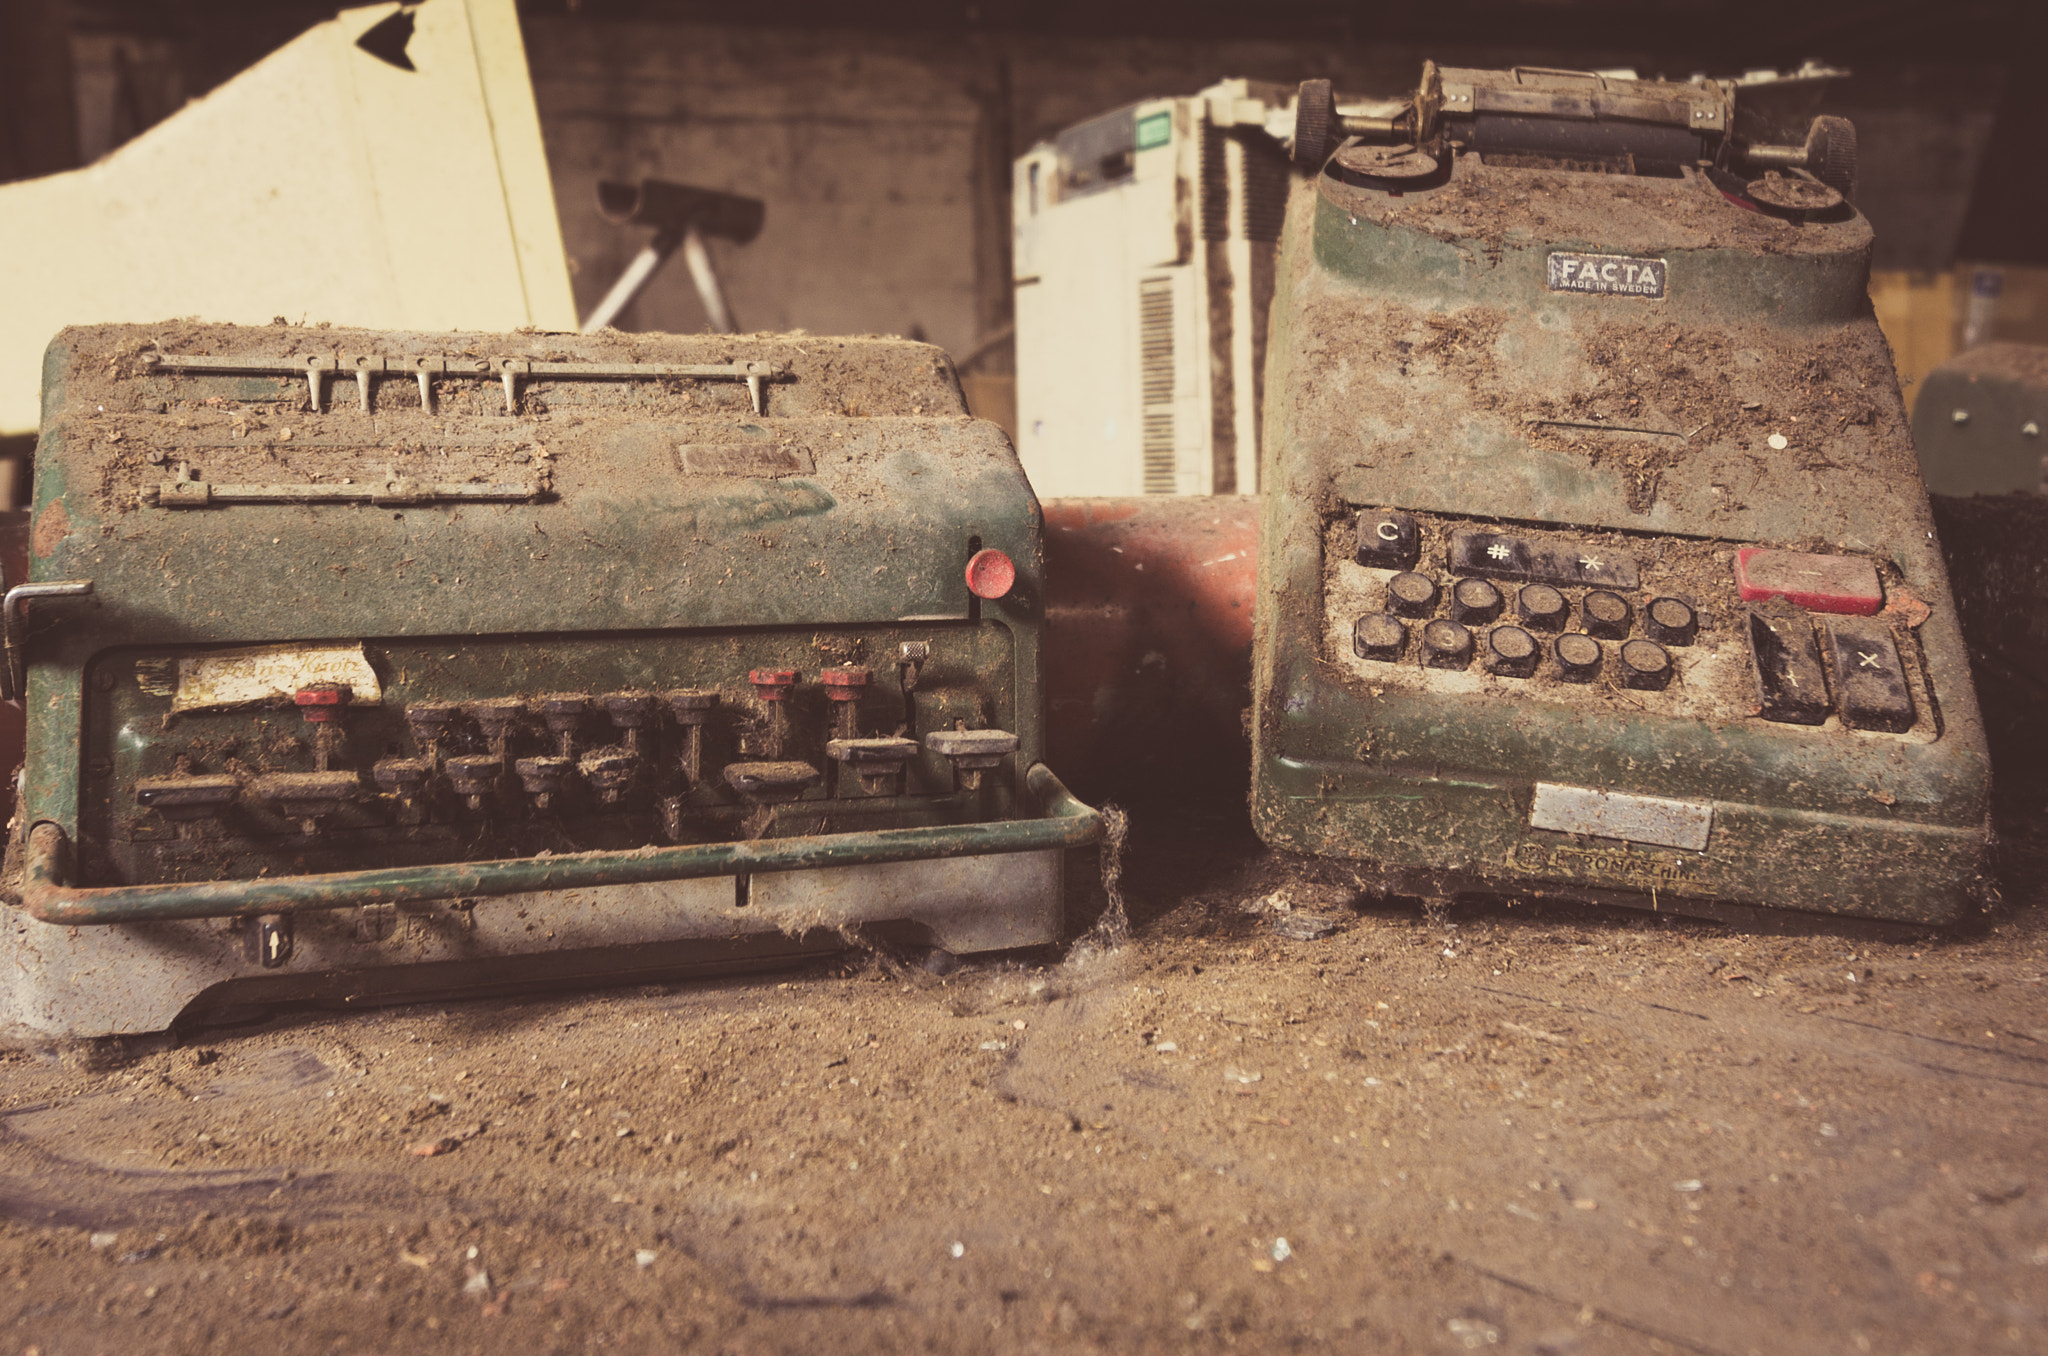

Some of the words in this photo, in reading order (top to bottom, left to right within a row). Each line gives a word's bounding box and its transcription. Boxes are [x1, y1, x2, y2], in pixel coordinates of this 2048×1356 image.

[1562, 259, 1657, 285] FACTA
[1560, 280, 1591, 289] MADE
[1596, 281, 1607, 290] IN
[1612, 282, 1657, 294] SWEDEN
[1376, 521, 1399, 541] C
